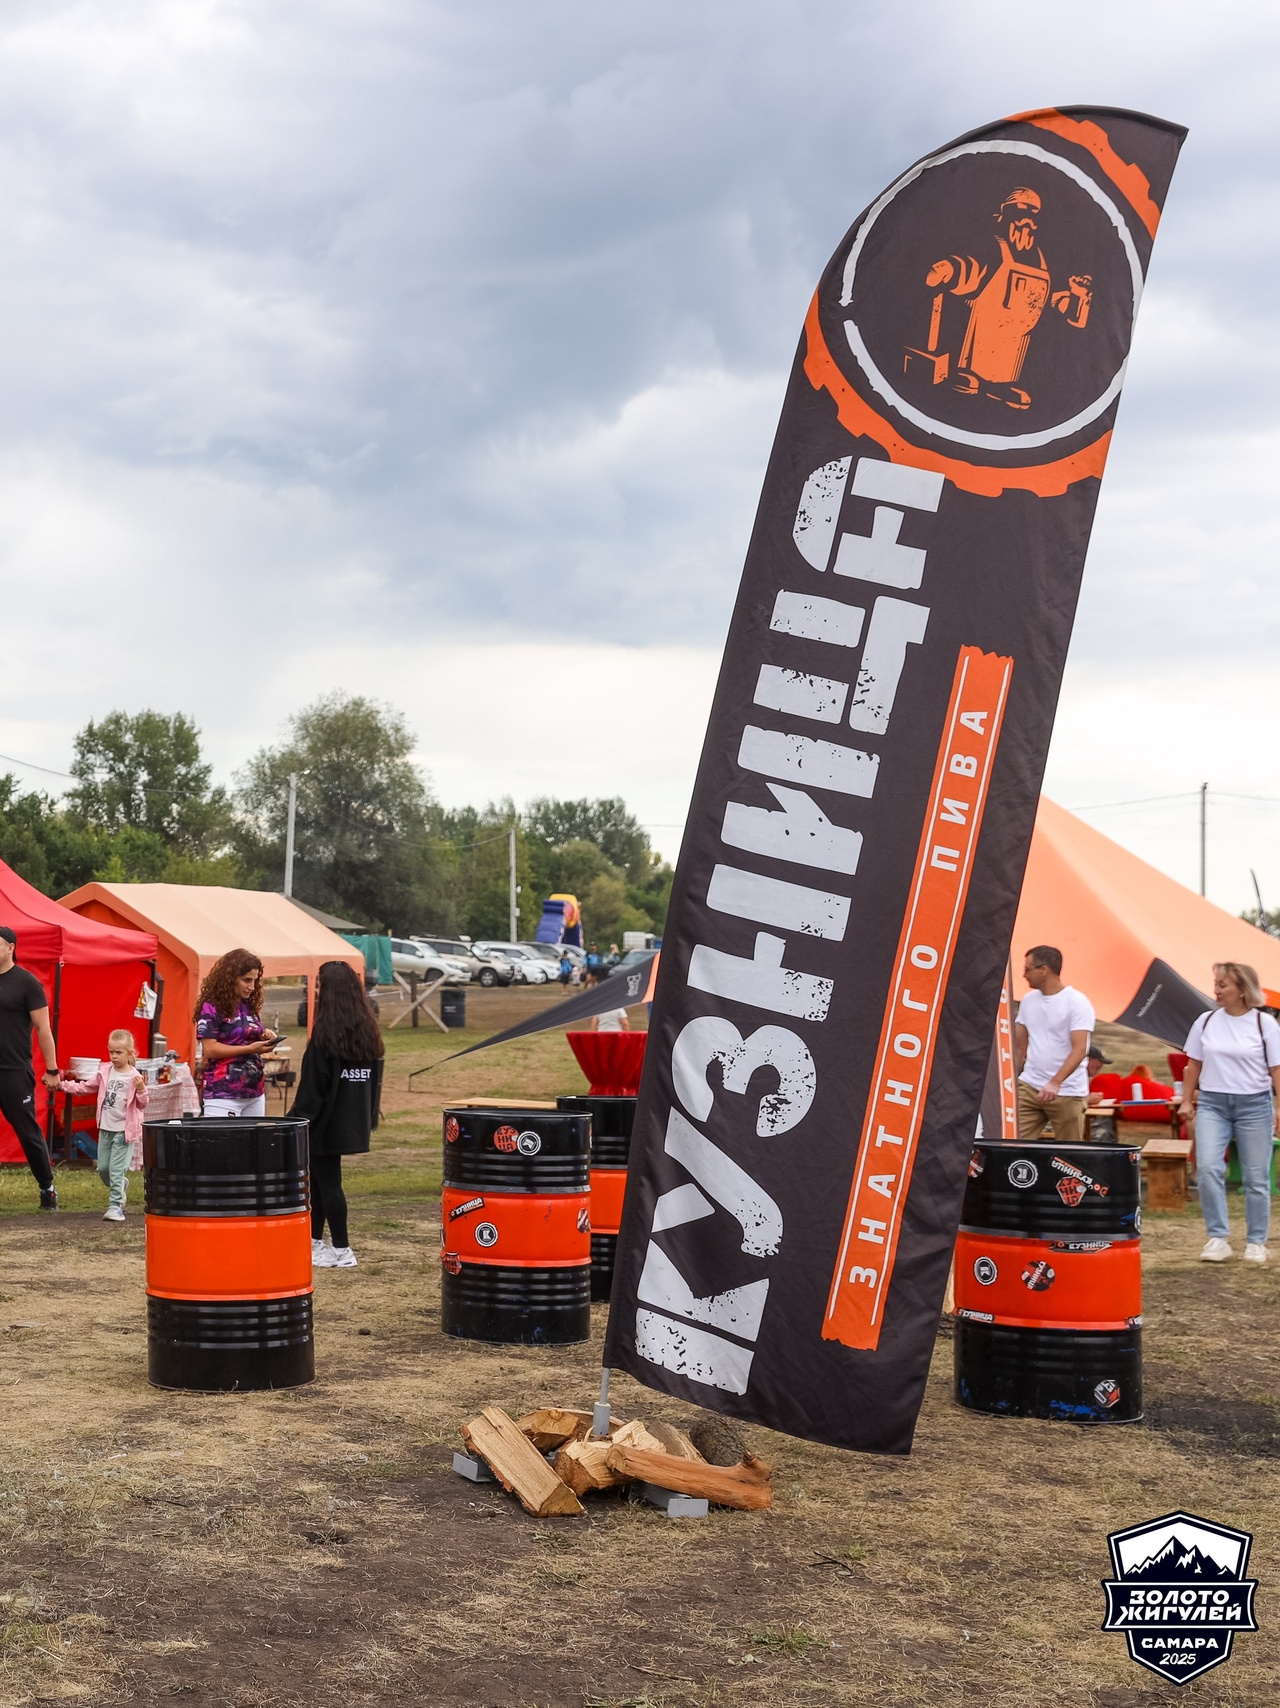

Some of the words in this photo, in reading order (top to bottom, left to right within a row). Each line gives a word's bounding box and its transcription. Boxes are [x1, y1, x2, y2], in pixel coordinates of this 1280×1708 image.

[340, 1068, 372, 1079] ASSET
[634, 455, 946, 1396] КУЗНИЦА
[848, 944, 938, 1290] ЗНАТНОГО
[930, 709, 989, 872] ПИВА
[1000, 987, 1016, 1123] НАТНО
